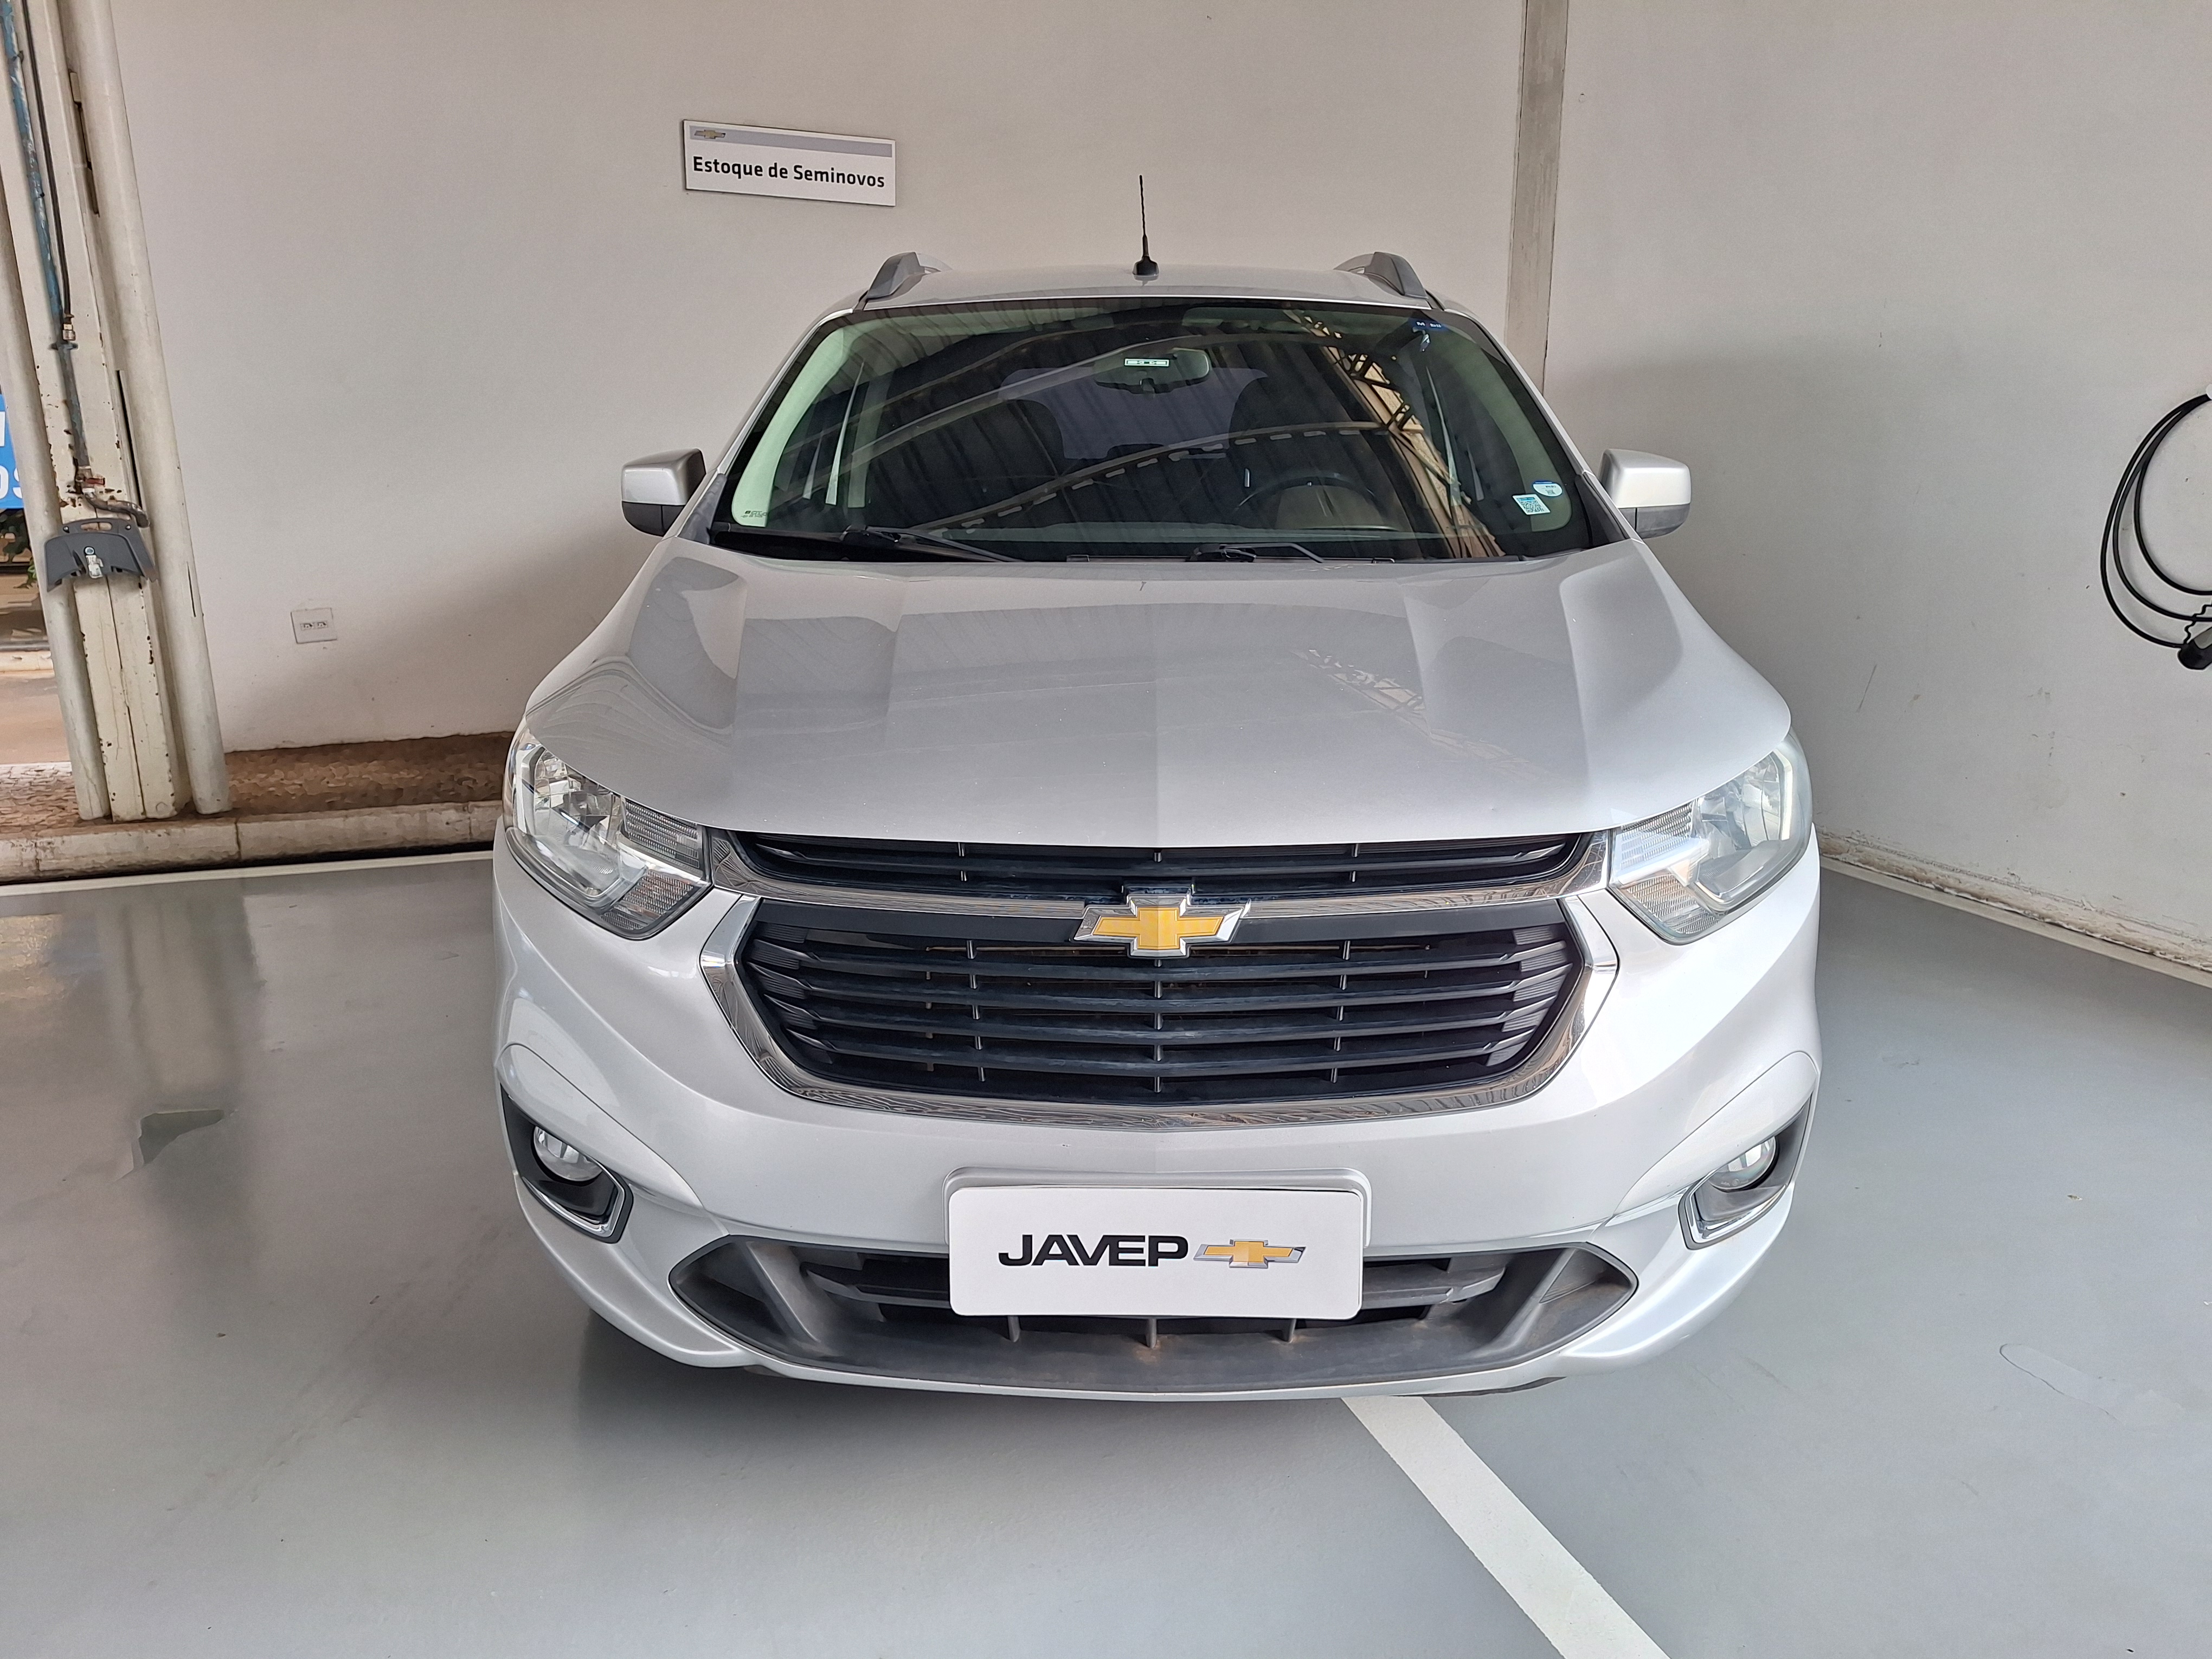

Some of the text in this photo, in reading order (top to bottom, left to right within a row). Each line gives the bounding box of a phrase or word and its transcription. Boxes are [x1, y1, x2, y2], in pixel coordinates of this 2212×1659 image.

[693, 156, 885, 188] Estoque de Seminovos
[998, 1234, 1188, 1267] JAVEP
